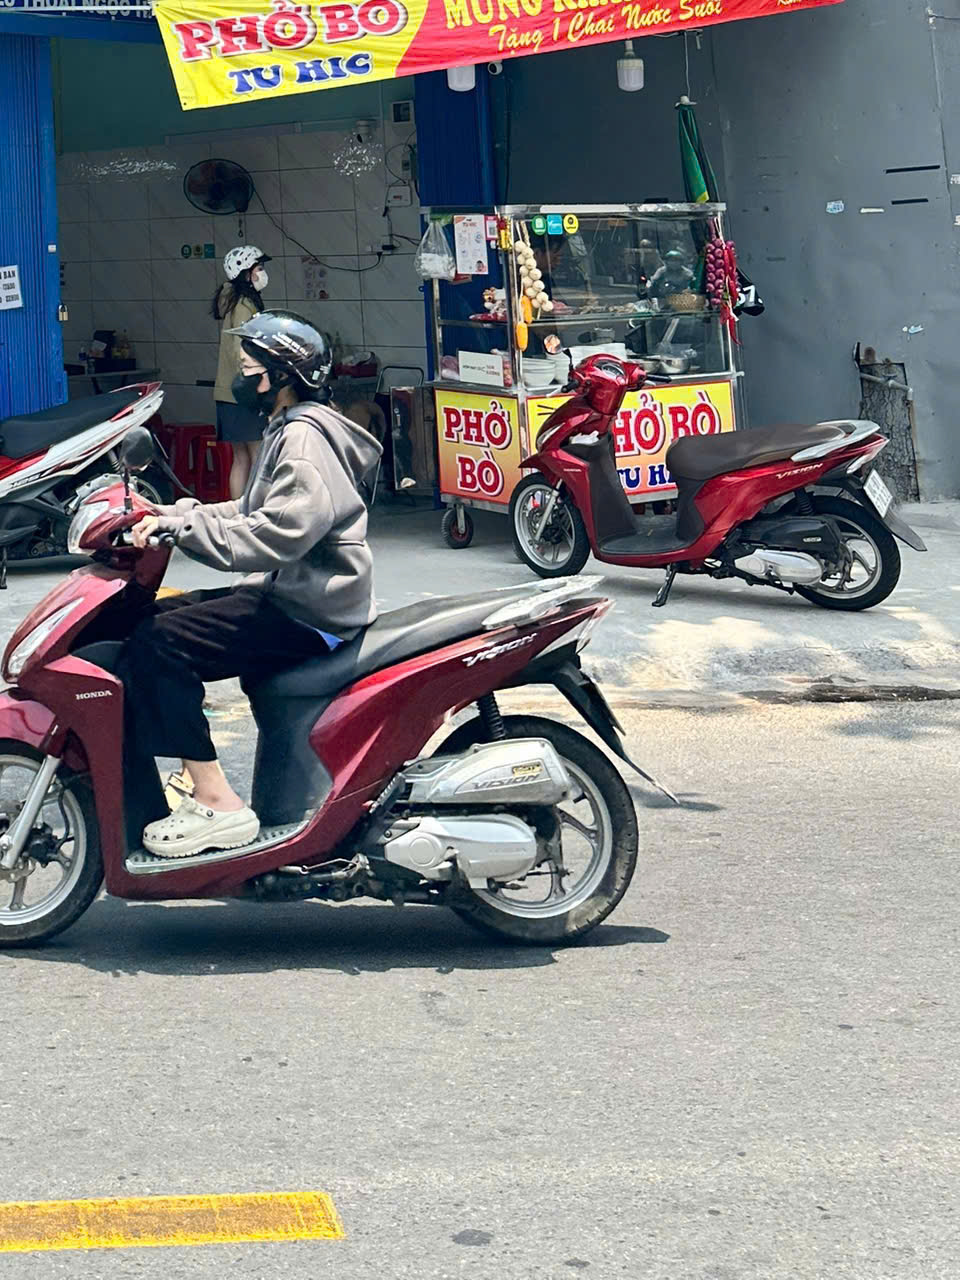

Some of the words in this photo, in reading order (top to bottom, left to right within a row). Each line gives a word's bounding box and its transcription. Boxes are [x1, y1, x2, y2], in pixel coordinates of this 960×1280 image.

[174, 0, 317, 63] PHỞ
[488, 24, 545, 55] Tặng
[552, 17, 560, 41] 1
[567, 12, 615, 43] Chai
[621, 3, 672, 30] Nước
[228, 65, 283, 95] TU
[294, 51, 374, 86] HIC
[443, 401, 512, 449] PHỞ
[612, 392, 666, 456] HỞ
[456, 451, 504, 496] BÒ
[75, 689, 113, 700] HONDA
